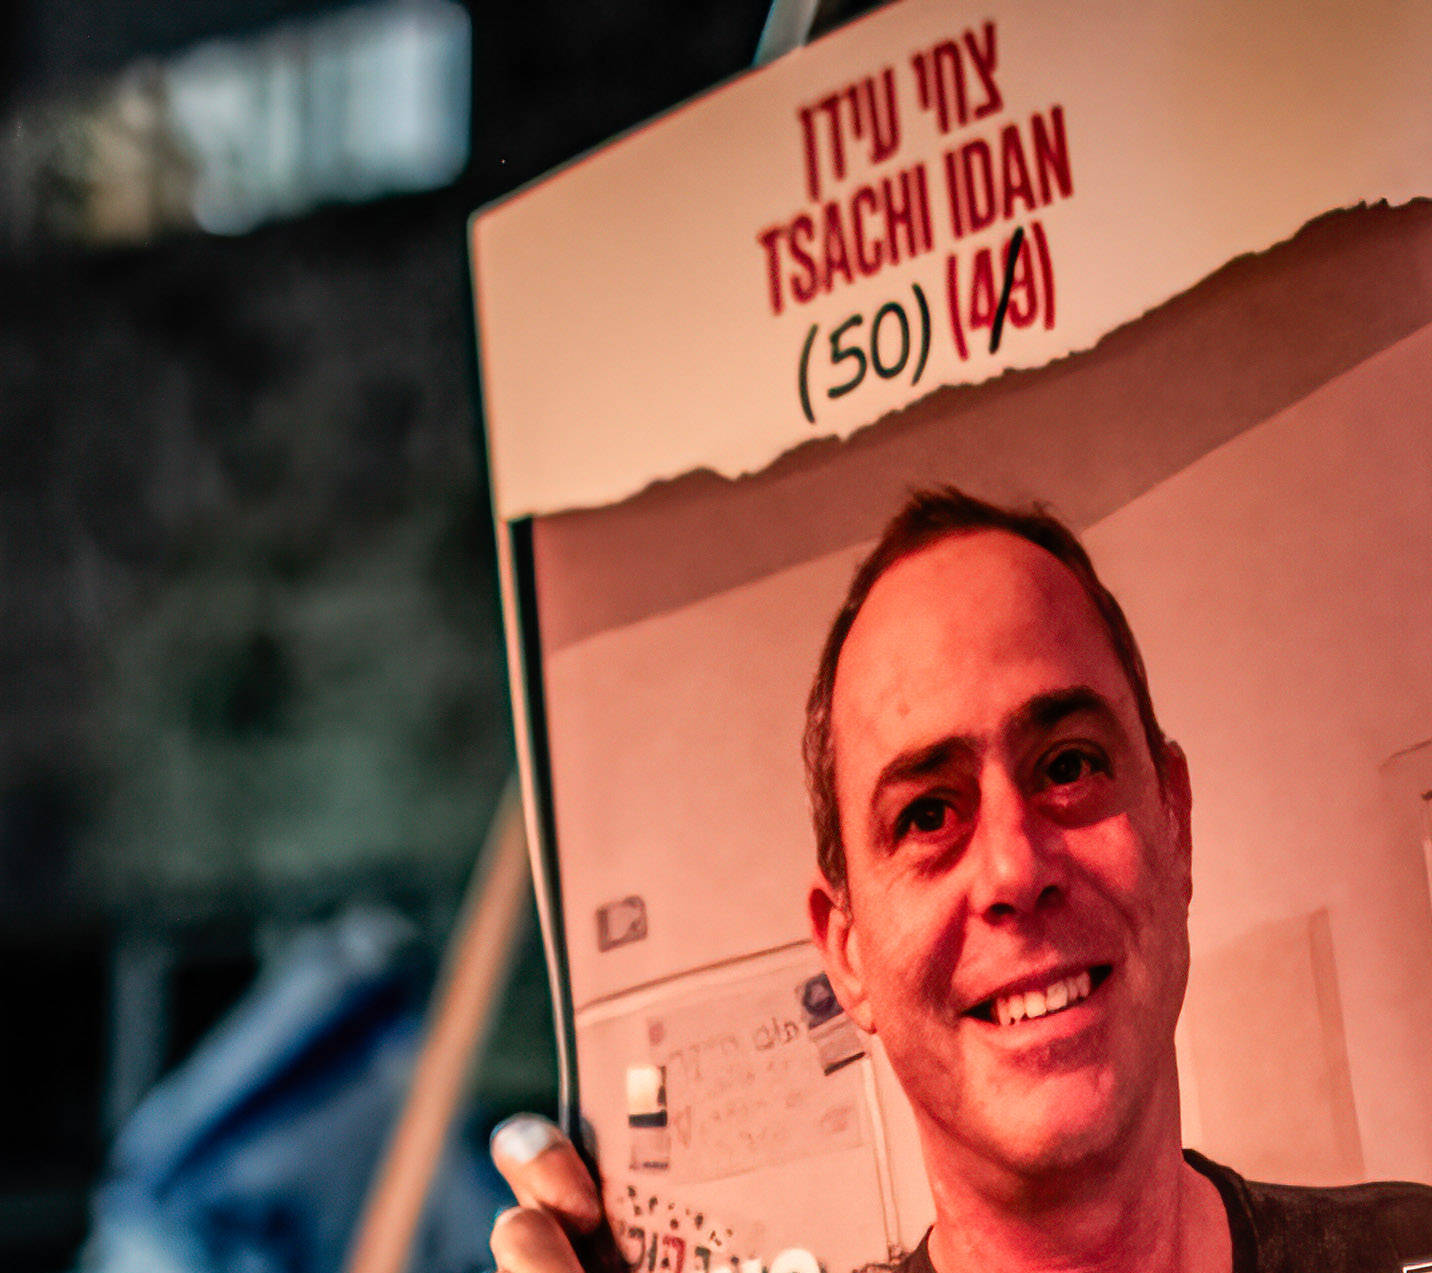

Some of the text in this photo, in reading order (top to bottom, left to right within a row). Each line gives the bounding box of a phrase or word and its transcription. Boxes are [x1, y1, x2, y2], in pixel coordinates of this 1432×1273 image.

[798, 20, 1004, 203] צחי עידן
[756, 104, 1074, 316] TSACHI IDAN
[799, 282, 931, 424] (50)
